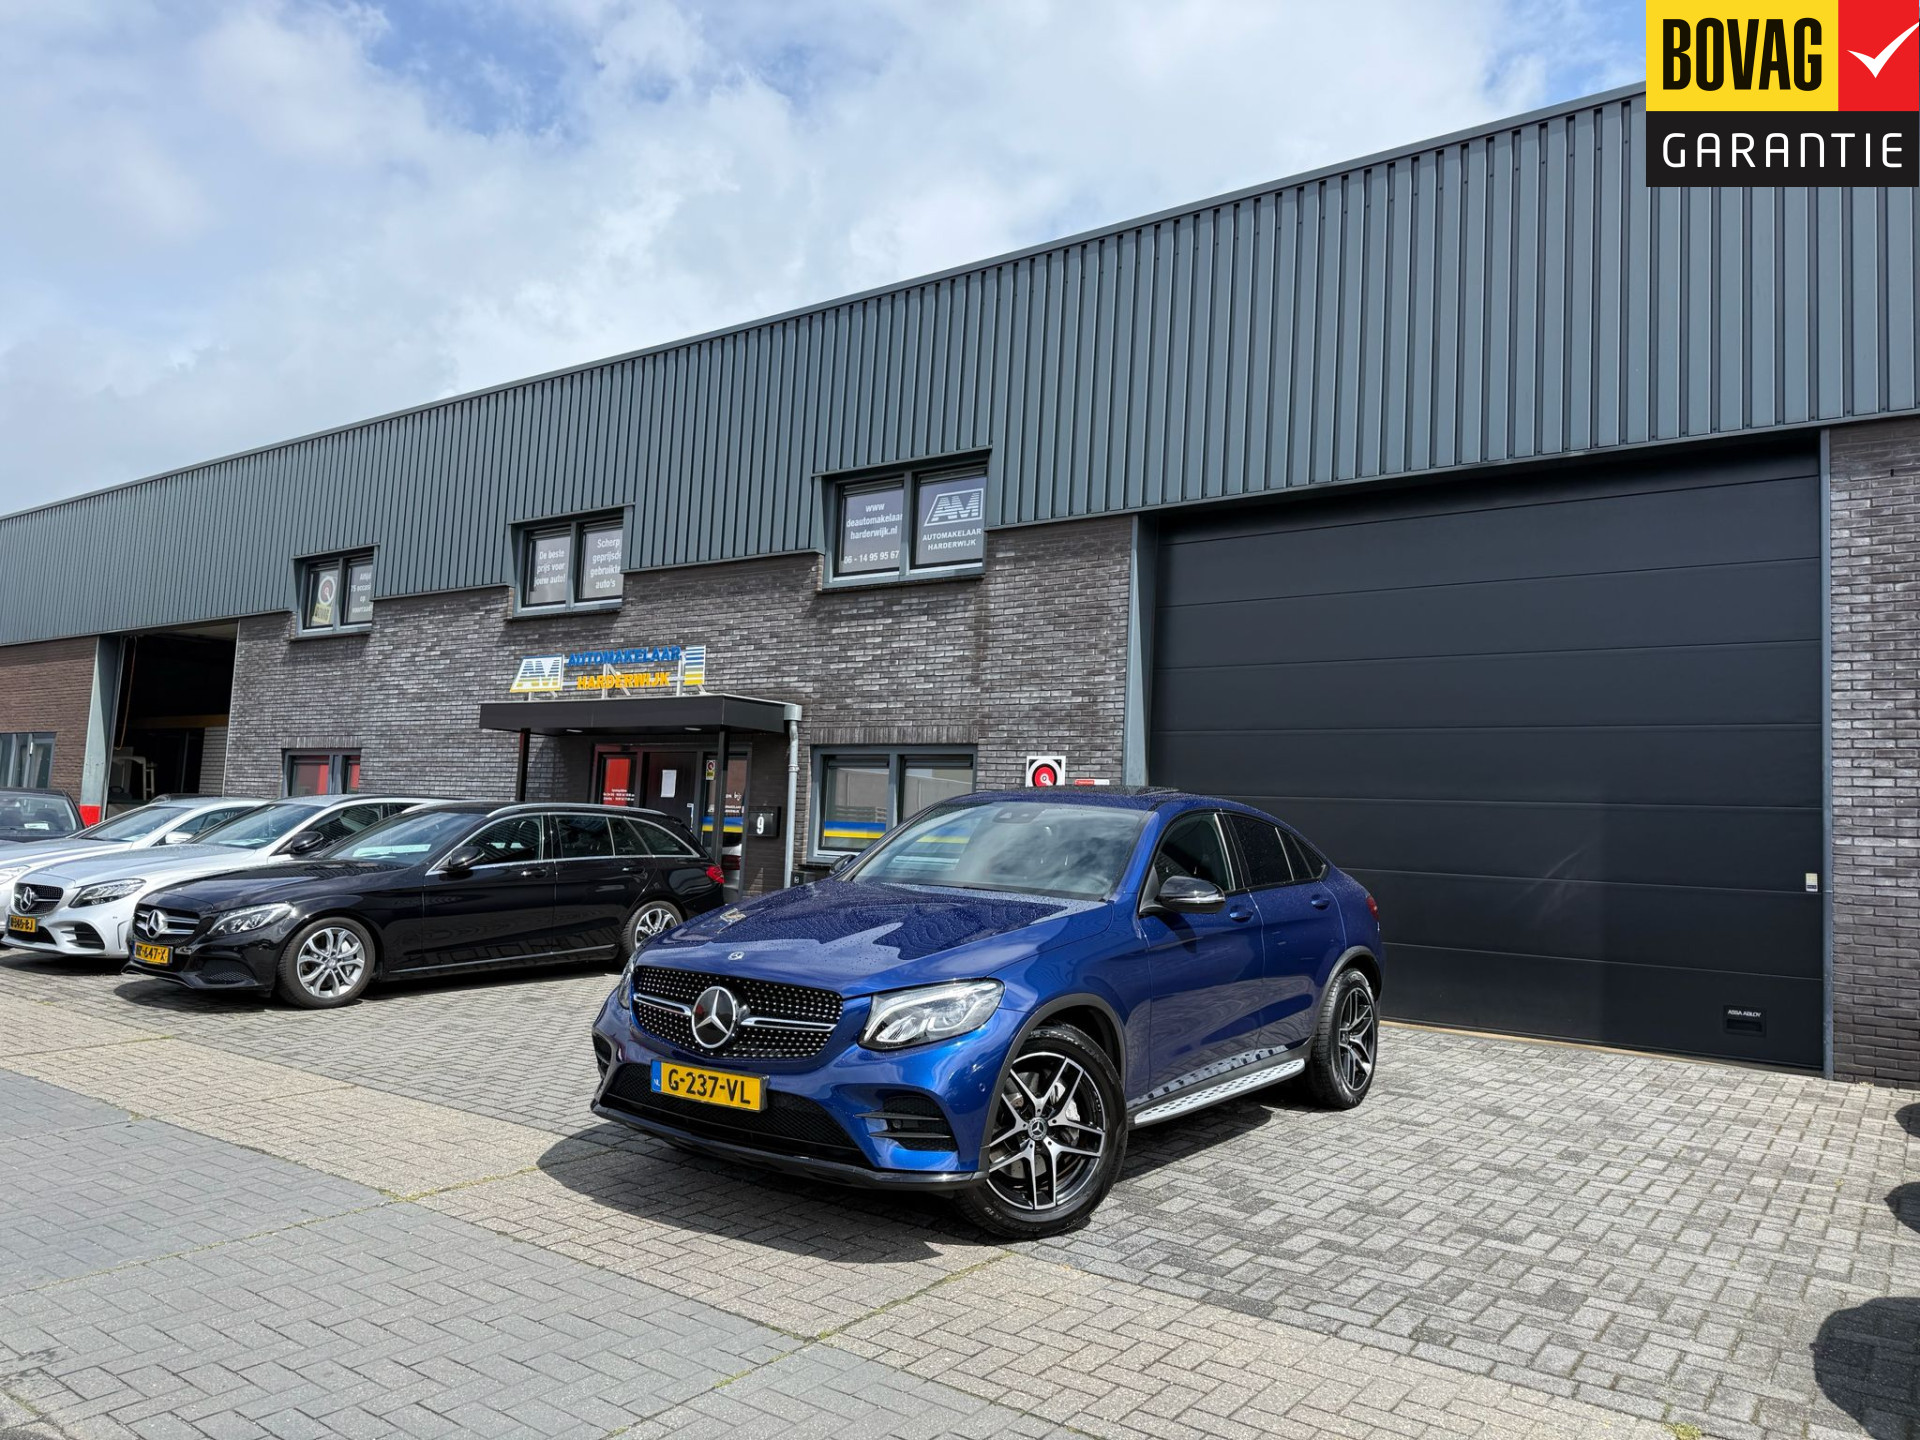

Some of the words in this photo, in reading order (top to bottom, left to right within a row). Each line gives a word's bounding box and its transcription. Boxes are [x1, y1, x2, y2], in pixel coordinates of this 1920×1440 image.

[865, 503, 885, 512] www
[850, 525, 898, 540] harderwijk.nl
[922, 528, 982, 541] AUTOMAKELAAR
[597, 538, 621, 549] Scherp
[927, 539, 977, 551] HARDERWIJK
[539, 551, 547, 560] De
[548, 549, 565, 559] beste
[844, 555, 853, 564] 06
[859, 554, 867, 563] 14
[870, 553, 878, 561] 95
[880, 551, 889, 560] 95
[890, 550, 900, 559] 67
[551, 563, 565, 571] voor
[595, 579, 616, 589] auto's
[567, 646, 682, 667] AUTOMAKELAAR
[576, 671, 671, 690] HARDERWIJK
[756, 816, 764, 834] 9
[668, 1068, 751, 1105] G-237-VL
